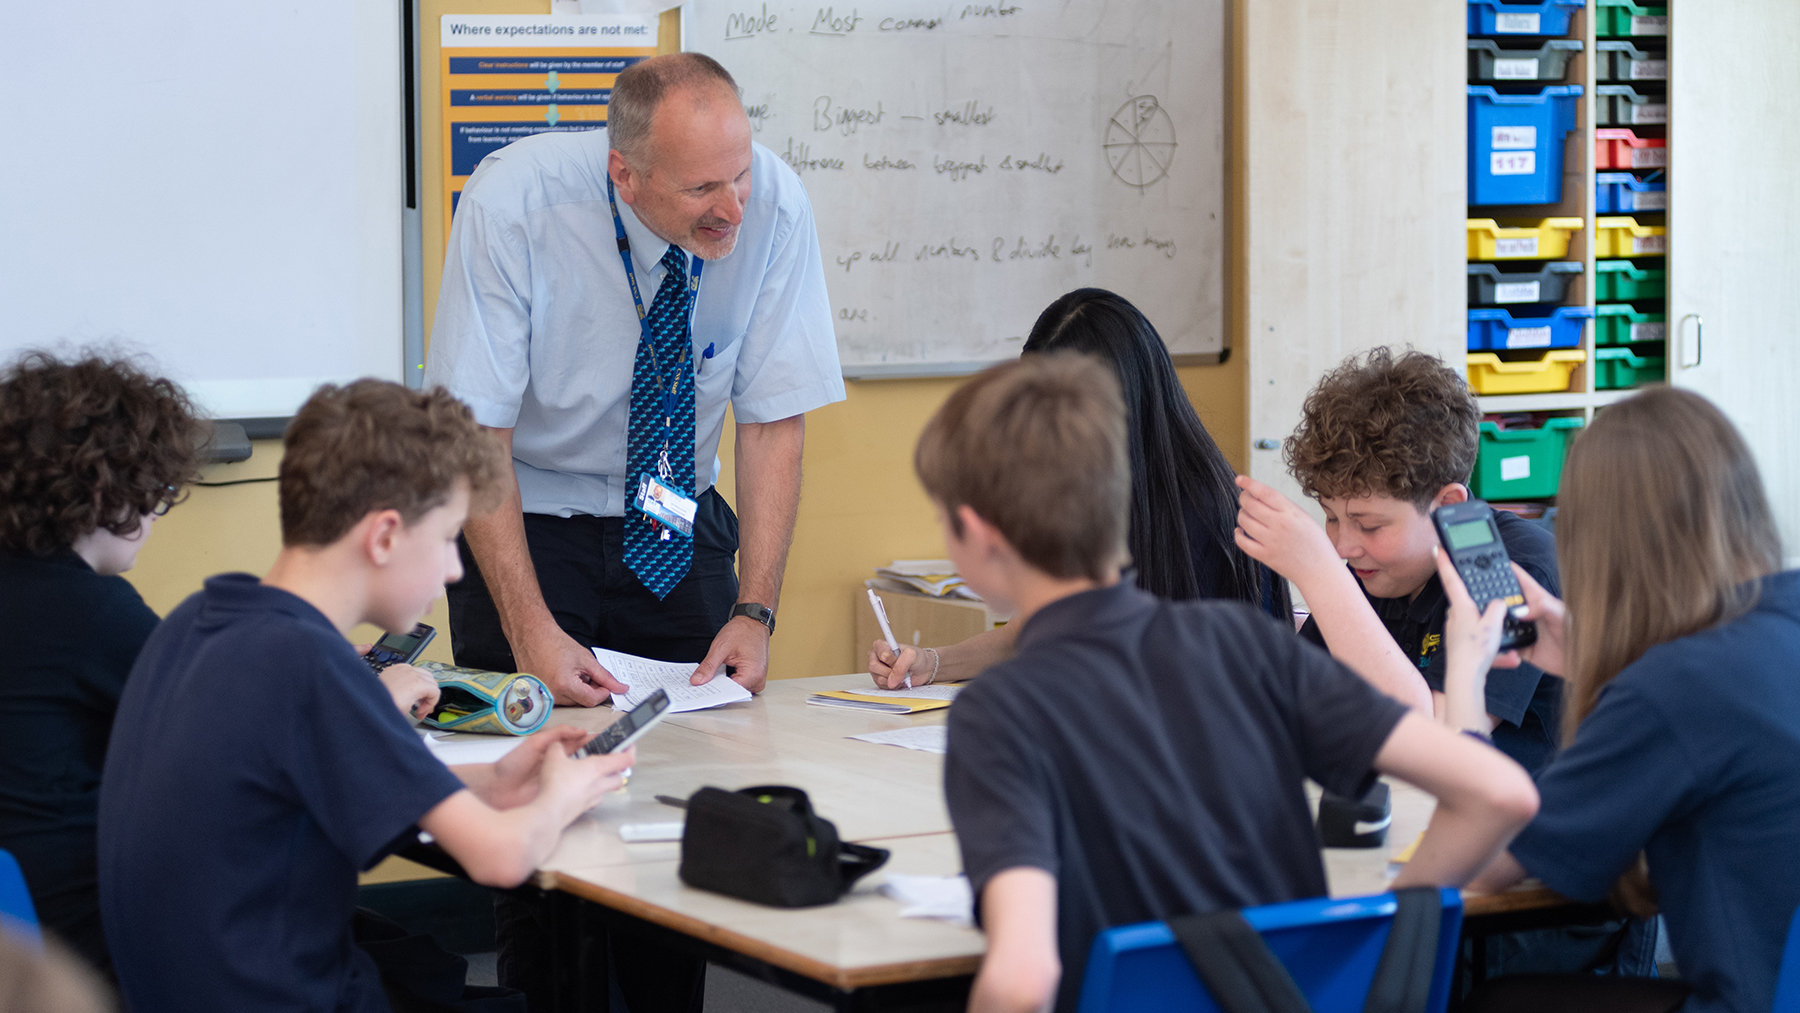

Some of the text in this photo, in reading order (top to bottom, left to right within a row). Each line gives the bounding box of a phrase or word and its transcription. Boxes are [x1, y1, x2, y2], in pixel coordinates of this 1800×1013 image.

[811, 6, 864, 32] Most
[878, 17, 943, 31] common
[450, 23, 649, 38] Where expectations are not met:
[469, 94, 476, 102] A
[814, 95, 887, 136] Biggest
[933, 99, 997, 126] smallest
[836, 250, 862, 272] up
[638, 482, 648, 501] Staff
